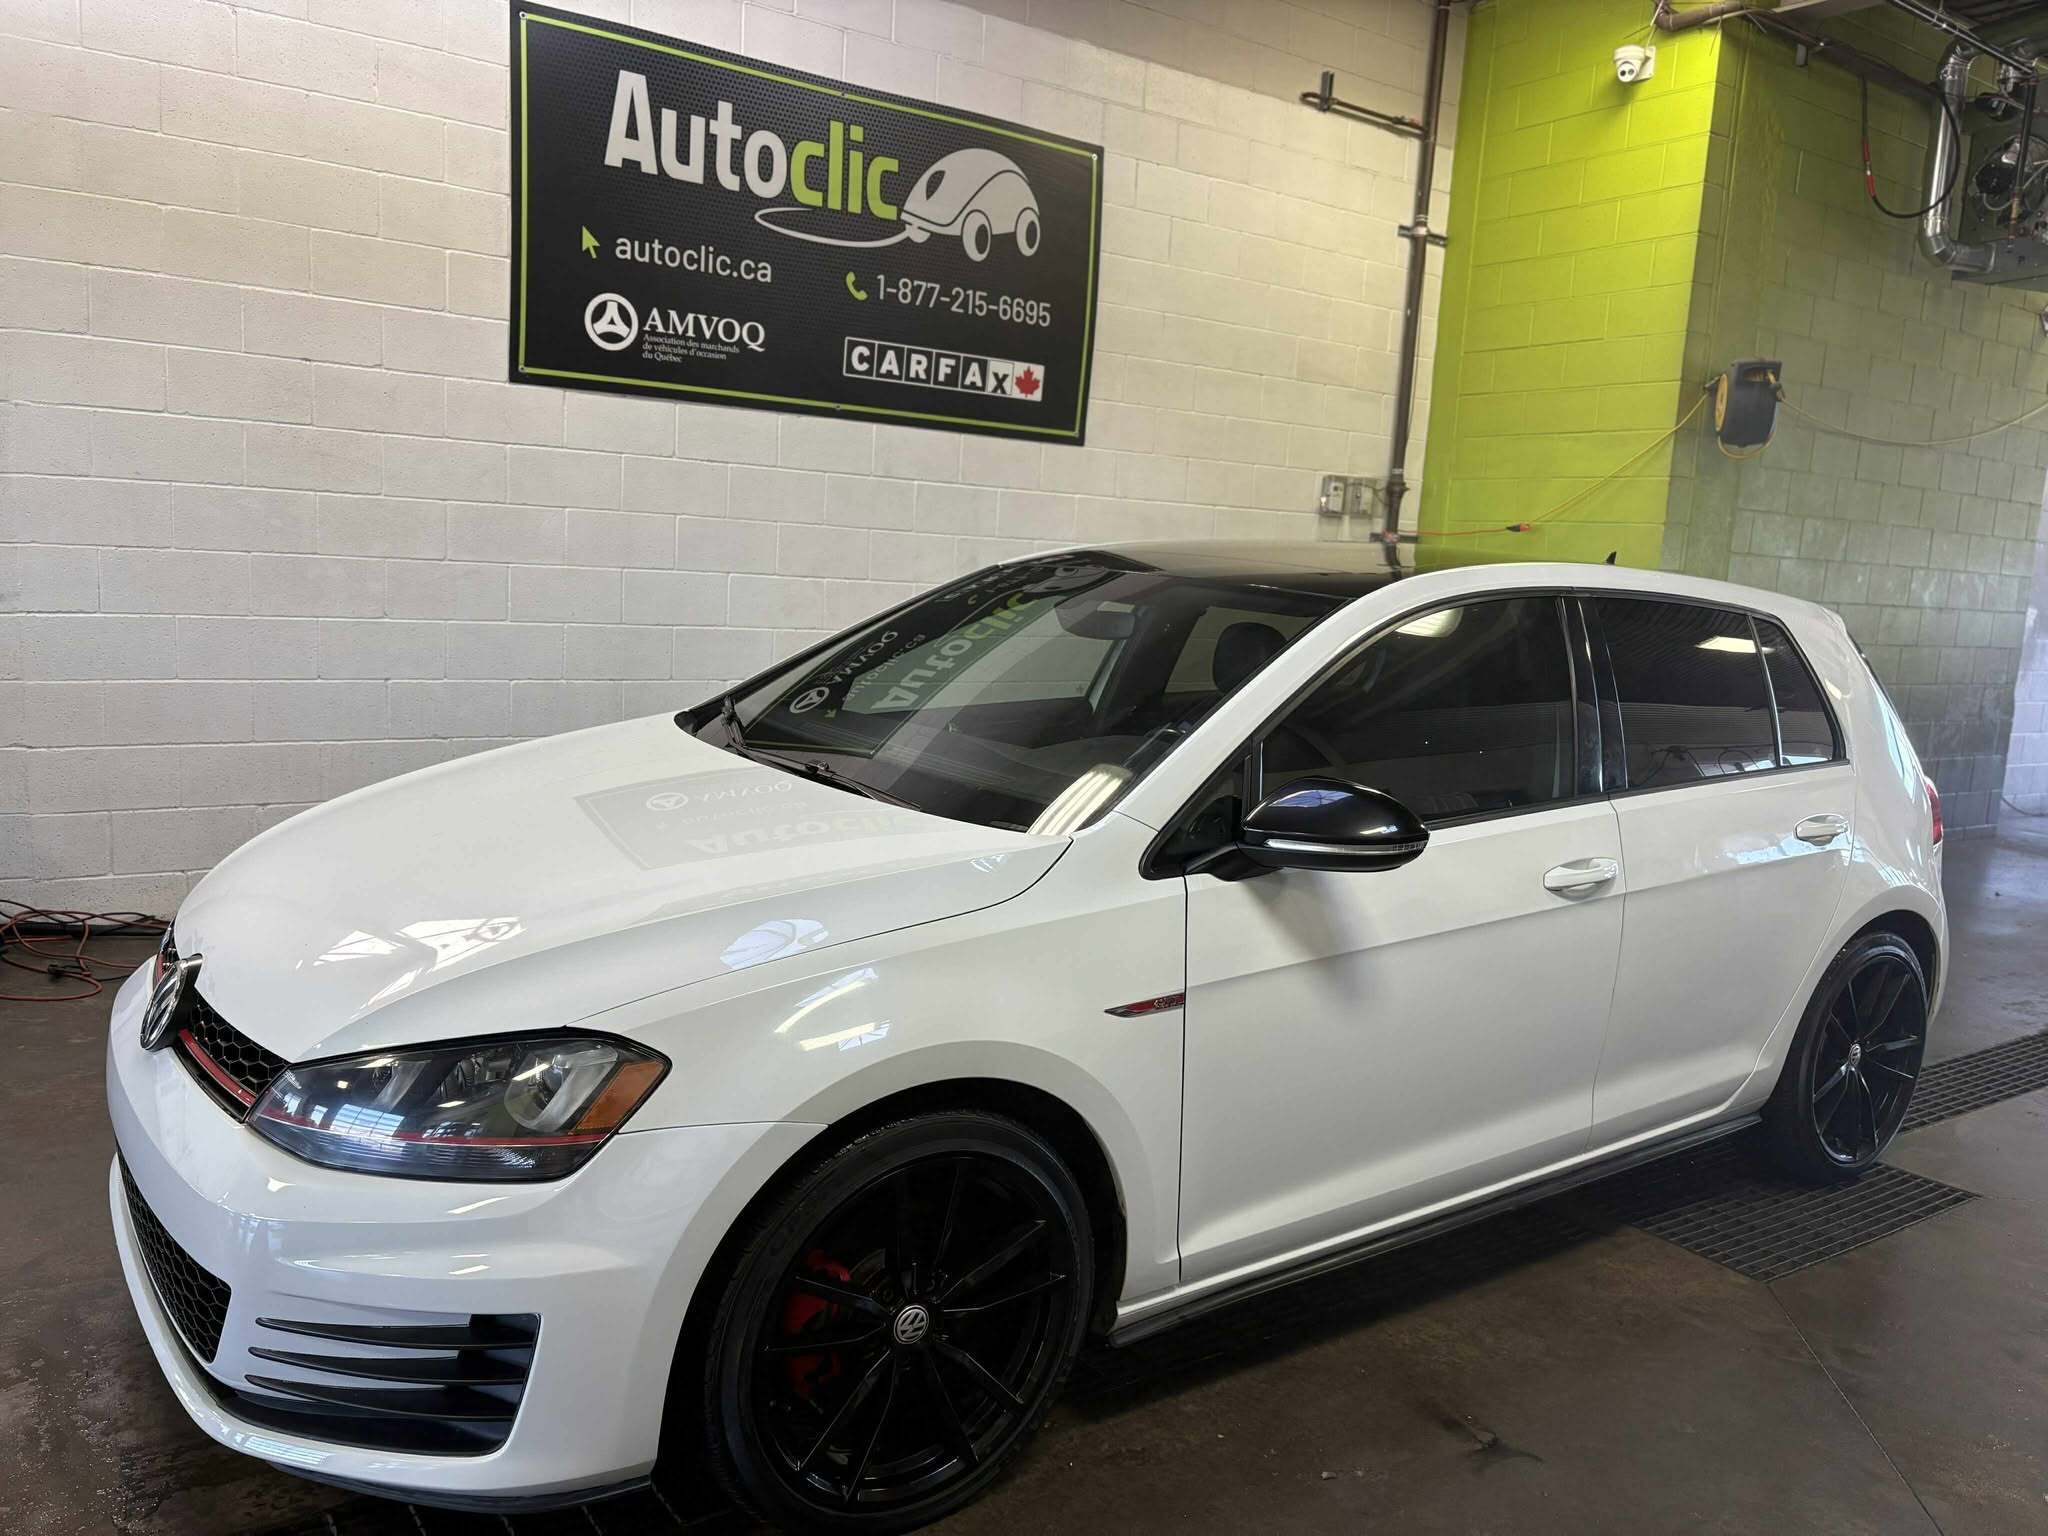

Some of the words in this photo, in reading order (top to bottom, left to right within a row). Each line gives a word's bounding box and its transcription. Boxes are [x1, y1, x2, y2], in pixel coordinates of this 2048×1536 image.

[604, 69, 900, 221] Autoclic
[615, 237, 773, 284] autoclic.ca
[876, 274, 1052, 328] 1-877-215-6695
[642, 342, 652, 351] de
[653, 343, 688, 355] véhicules
[643, 307, 766, 353] AMVOQ
[643, 333, 686, 346] Association
[686, 339, 699, 348] des
[700, 342, 740, 354] marchands
[642, 350, 653, 360] du
[654, 351, 683, 363] Québec
[850, 344, 1010, 396] CARFAX
